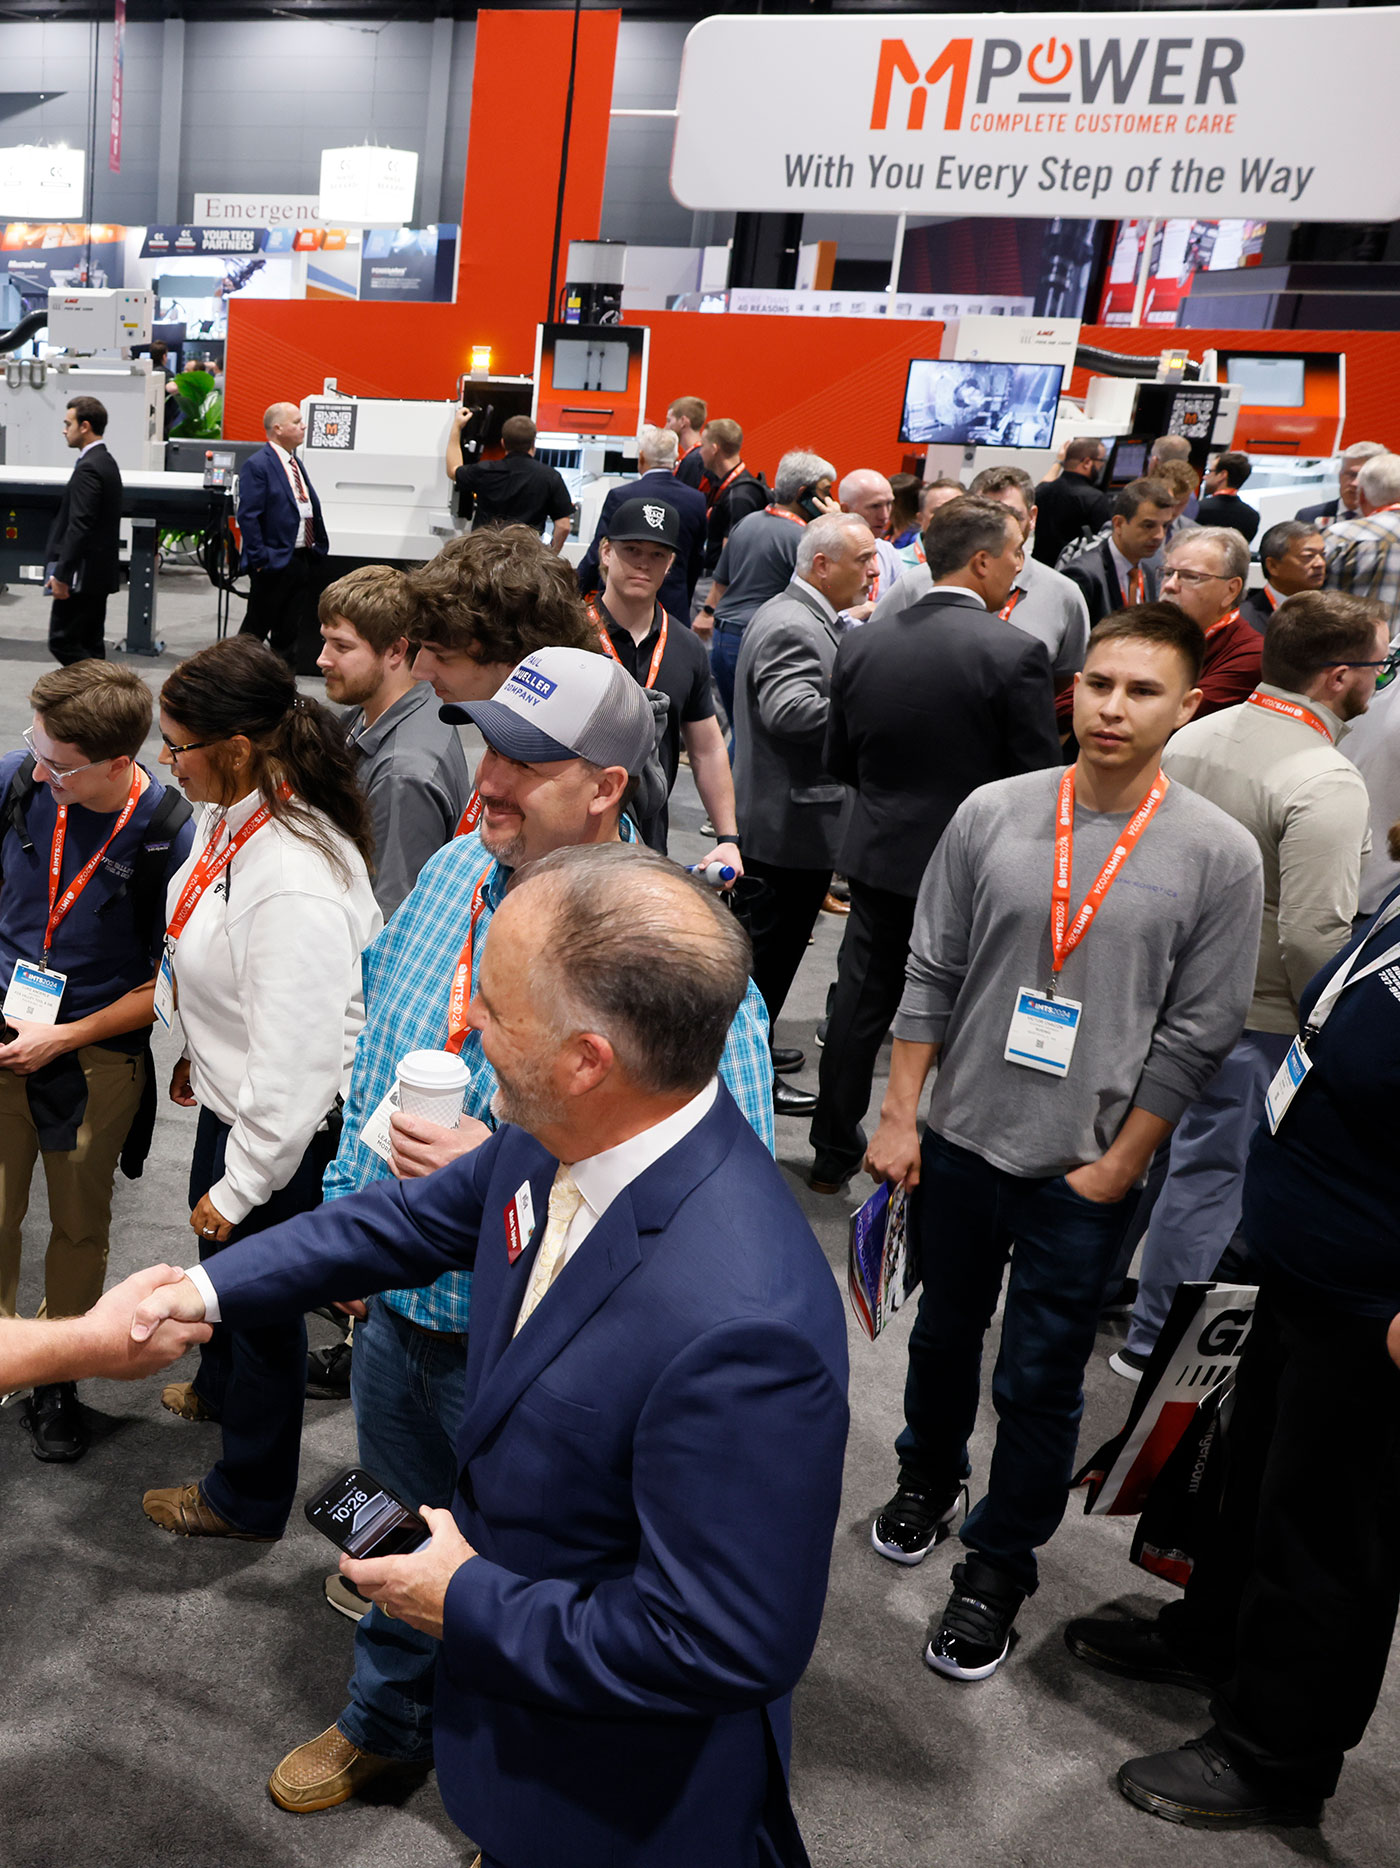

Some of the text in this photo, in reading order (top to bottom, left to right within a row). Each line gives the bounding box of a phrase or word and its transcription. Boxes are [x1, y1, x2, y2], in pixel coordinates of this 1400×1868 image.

[970, 113, 1238, 134] COMPLETE CUSTOMER CARE
[785, 154, 1315, 201] With You Every Step of the Way
[202, 230, 255, 240] YOUR TECH
[202, 240, 254, 251] PARTNERS
[750, 304, 790, 313] REASONS
[527, 655, 543, 668] PAUL
[504, 683, 541, 707] COMPANY
[1061, 778, 1071, 817] IMTS2024
[1127, 797, 1157, 837] IMTS2024
[53, 829, 63, 867] IMTS2024
[1058, 836, 1069, 879] IMTS2024
[206, 849, 232, 880] IMTS2024
[1094, 853, 1122, 895] IMTS2024
[1055, 901, 1065, 944] IMTS2024
[29, 974, 58, 989] IMTS2024
[452, 975, 468, 1028] IMTS2024
[1035, 1003, 1071, 1018] IMTS2024
[332, 1490, 368, 1523] 10:26
